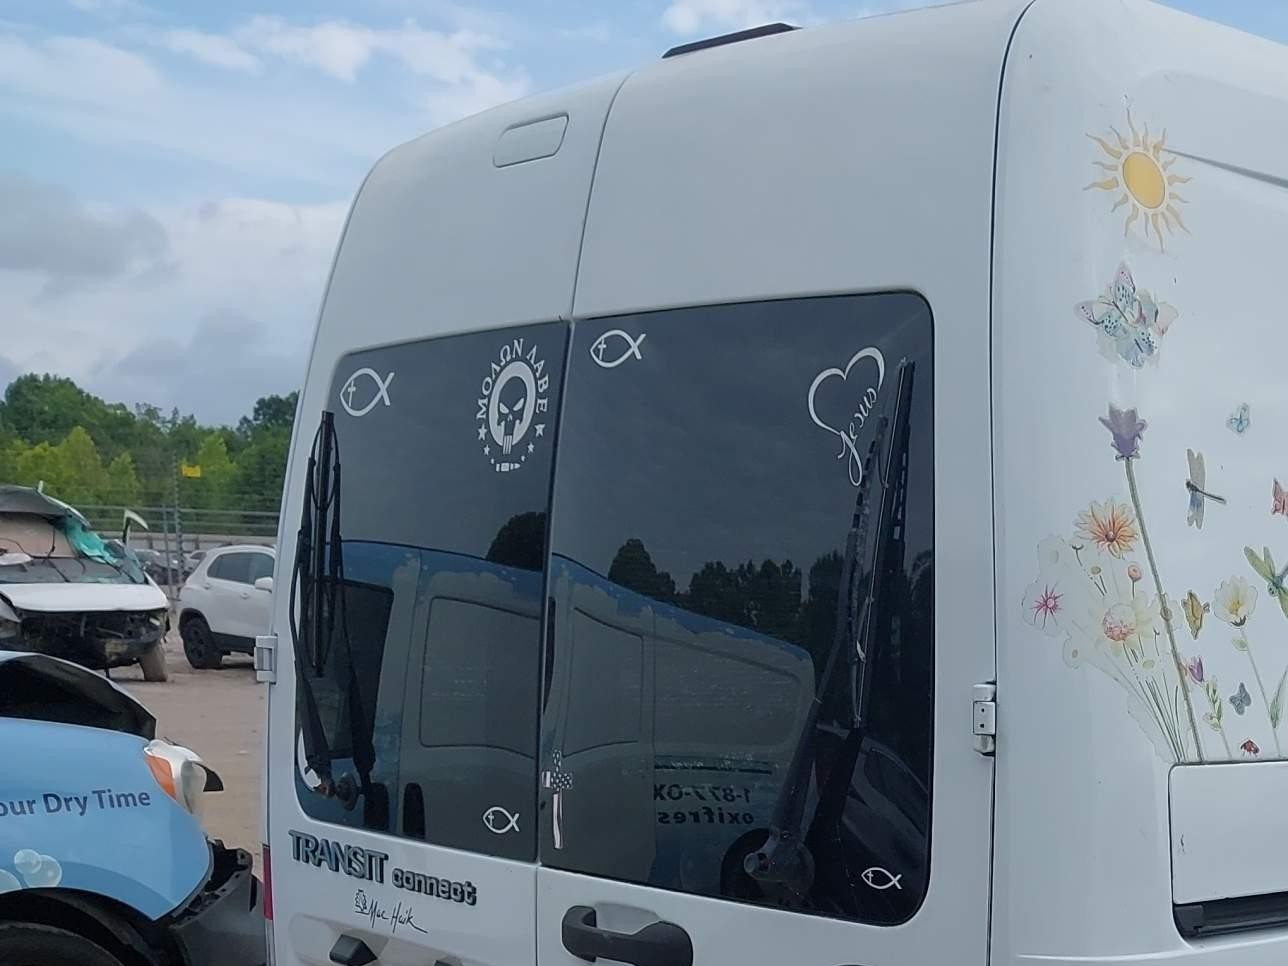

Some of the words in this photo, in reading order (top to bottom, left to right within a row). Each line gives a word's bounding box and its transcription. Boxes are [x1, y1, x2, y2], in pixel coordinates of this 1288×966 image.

[837, 387, 877, 486] Jesus
[42, 793, 88, 816] Dry
[92, 788, 151, 809] Time
[288, 829, 389, 884] TRANSIT
[391, 867, 477, 906] connect
